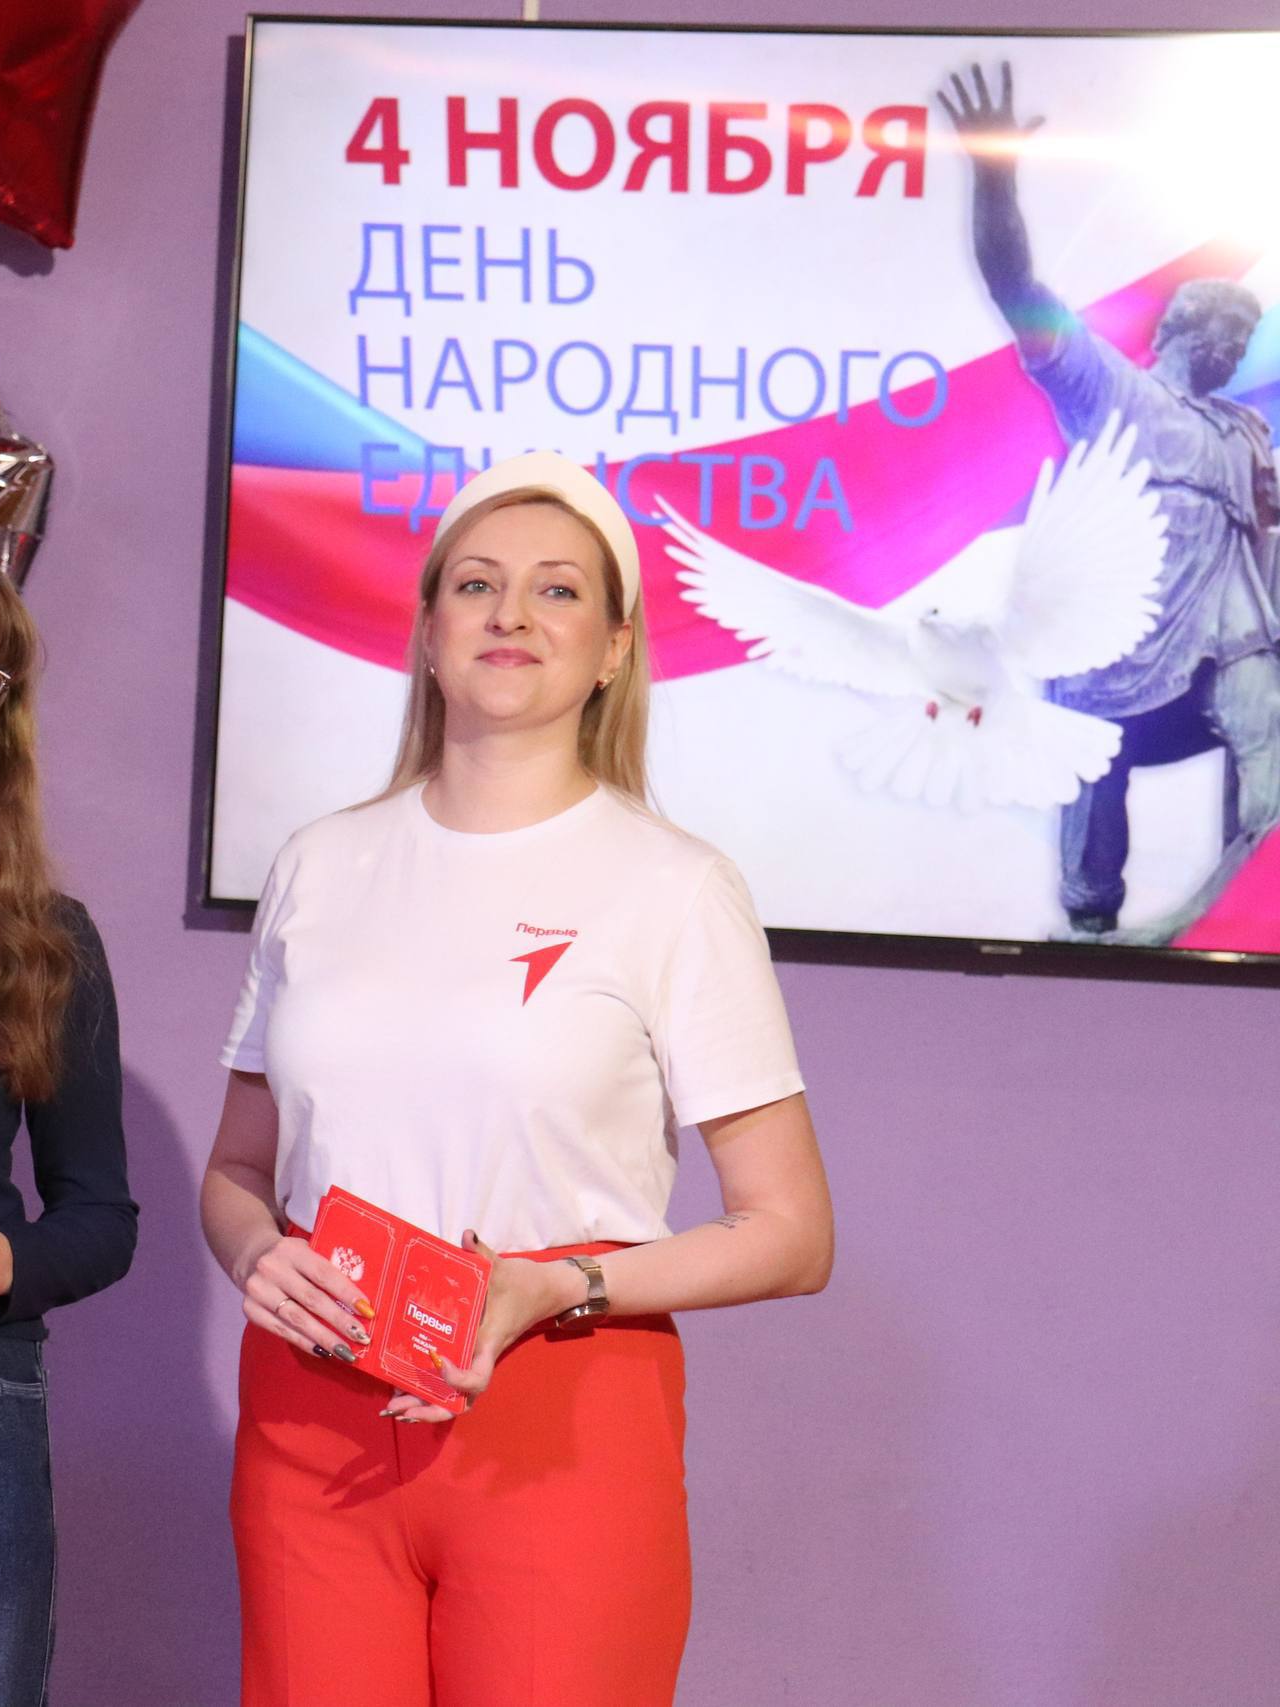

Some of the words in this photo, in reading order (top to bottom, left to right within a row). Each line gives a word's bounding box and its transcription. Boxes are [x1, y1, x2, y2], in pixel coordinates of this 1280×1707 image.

[345, 97, 411, 185] 4
[446, 96, 928, 198] НОЯБРЯ
[349, 222, 596, 316] ДЕНЬ
[357, 334, 949, 435] НАРОДНОГО
[360, 442, 854, 533] ЕДСТВА
[515, 922, 578, 938] Первые
[407, 1303, 453, 1335] Первые
